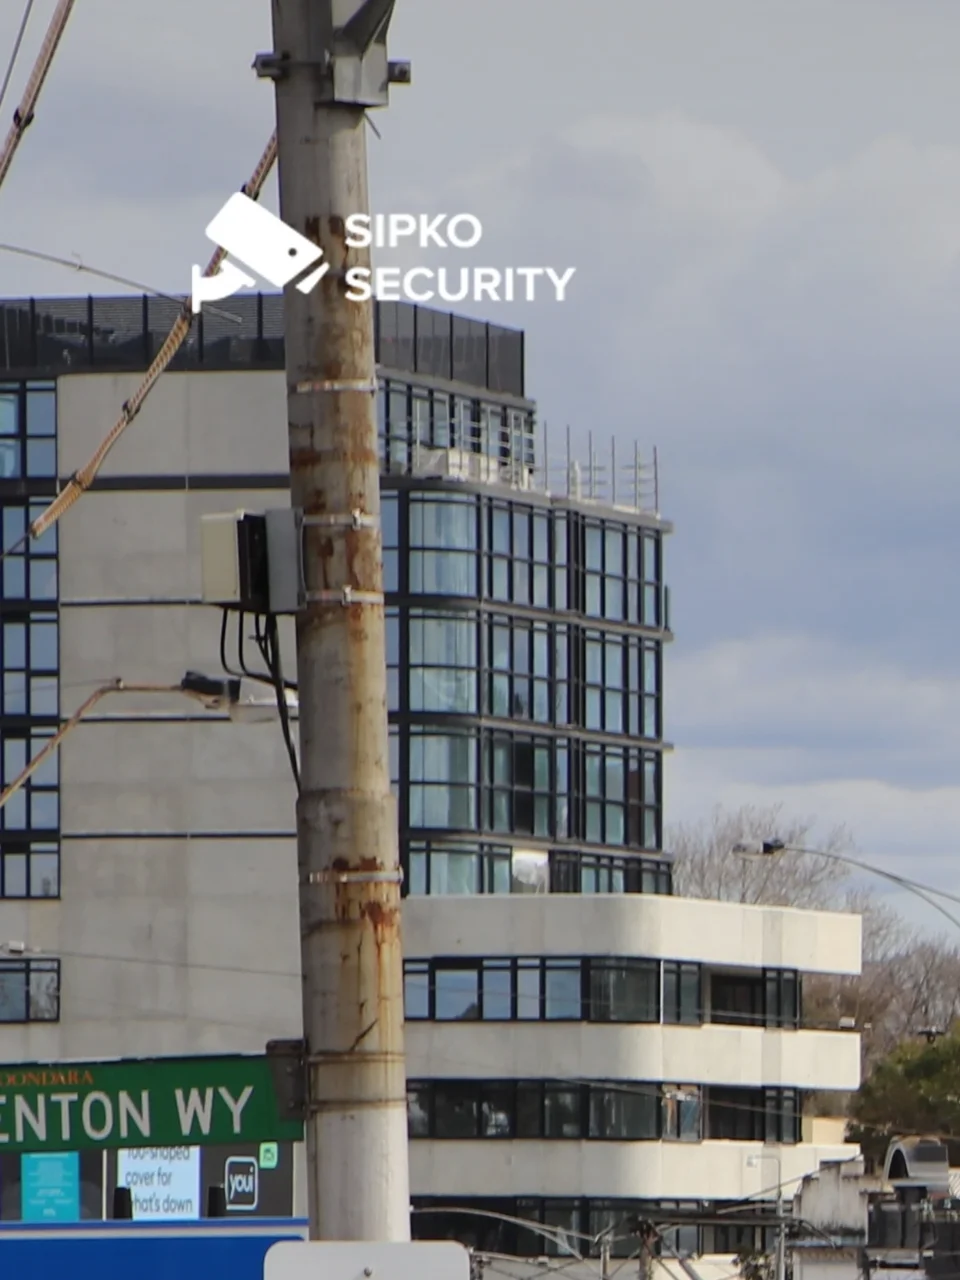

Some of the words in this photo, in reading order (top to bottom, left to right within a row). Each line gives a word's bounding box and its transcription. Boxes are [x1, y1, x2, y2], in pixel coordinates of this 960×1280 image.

[174, 1085, 254, 1137] WY
[125, 1170, 154, 1187] cover
[156, 1166, 173, 1186] for
[229, 1166, 254, 1200] youi
[131, 1192, 160, 1213] hat's
[162, 1193, 193, 1214] down
